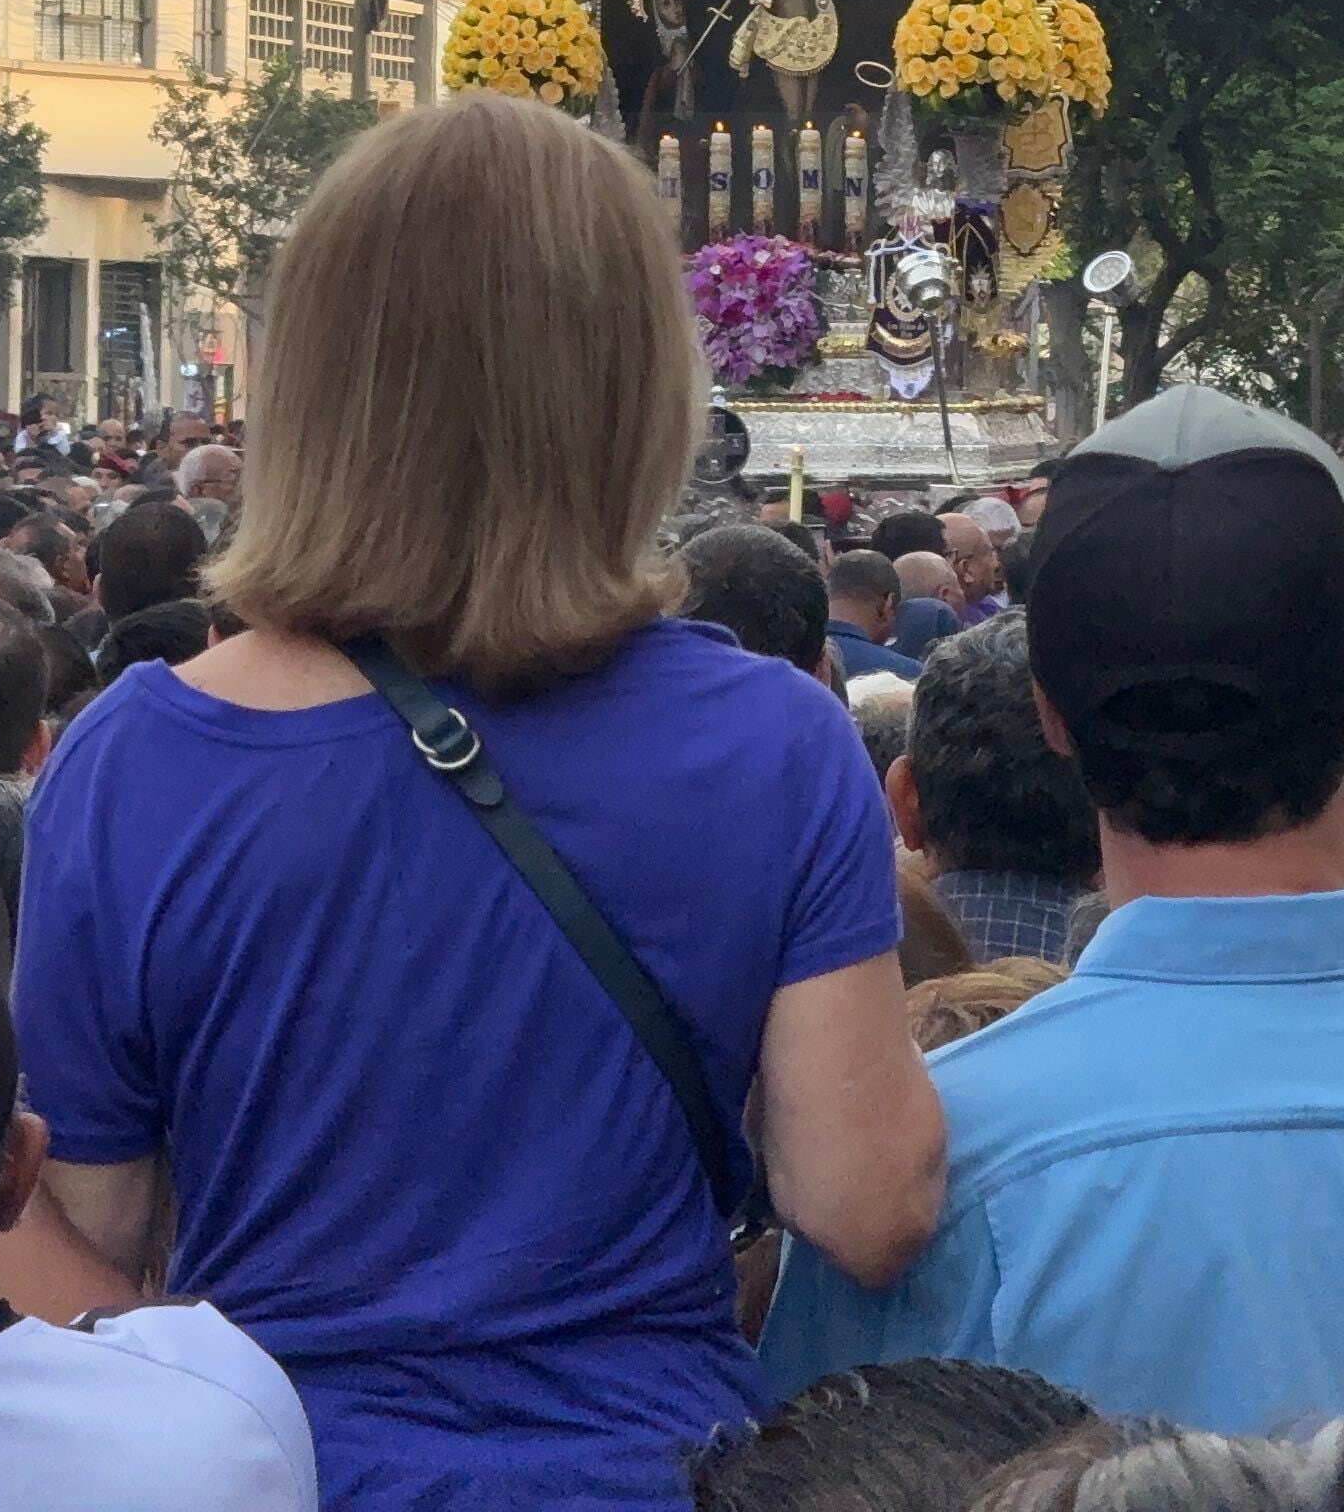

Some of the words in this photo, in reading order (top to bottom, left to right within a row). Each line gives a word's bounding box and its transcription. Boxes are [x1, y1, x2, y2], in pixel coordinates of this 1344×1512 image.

[710, 172, 728, 191] S
[802, 169, 819, 189] M
[846, 177, 864, 197] N
